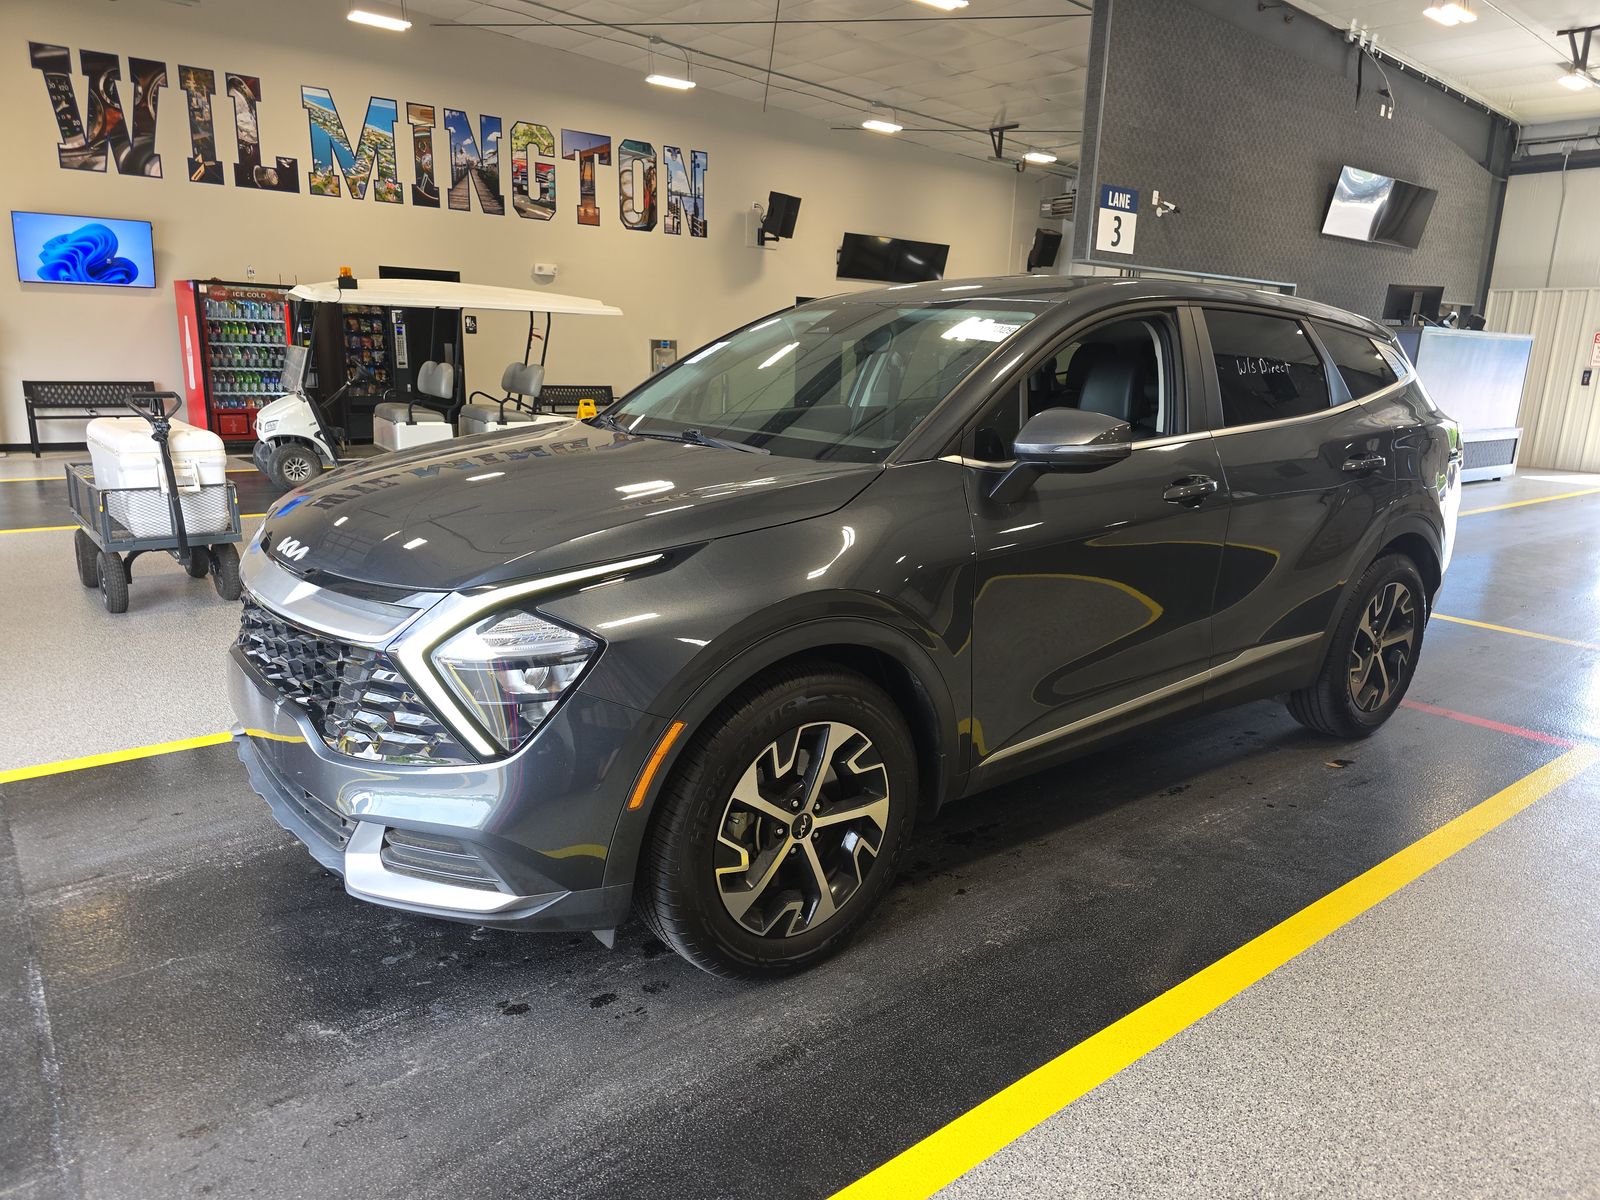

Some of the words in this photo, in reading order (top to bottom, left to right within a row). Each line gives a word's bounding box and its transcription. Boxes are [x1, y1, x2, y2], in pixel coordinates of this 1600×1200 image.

[28, 40, 709, 239] WILMINGTON
[1107, 190, 1132, 210] LANE
[1110, 215, 1123, 247] 3
[1259, 358, 1291, 374] Direct
